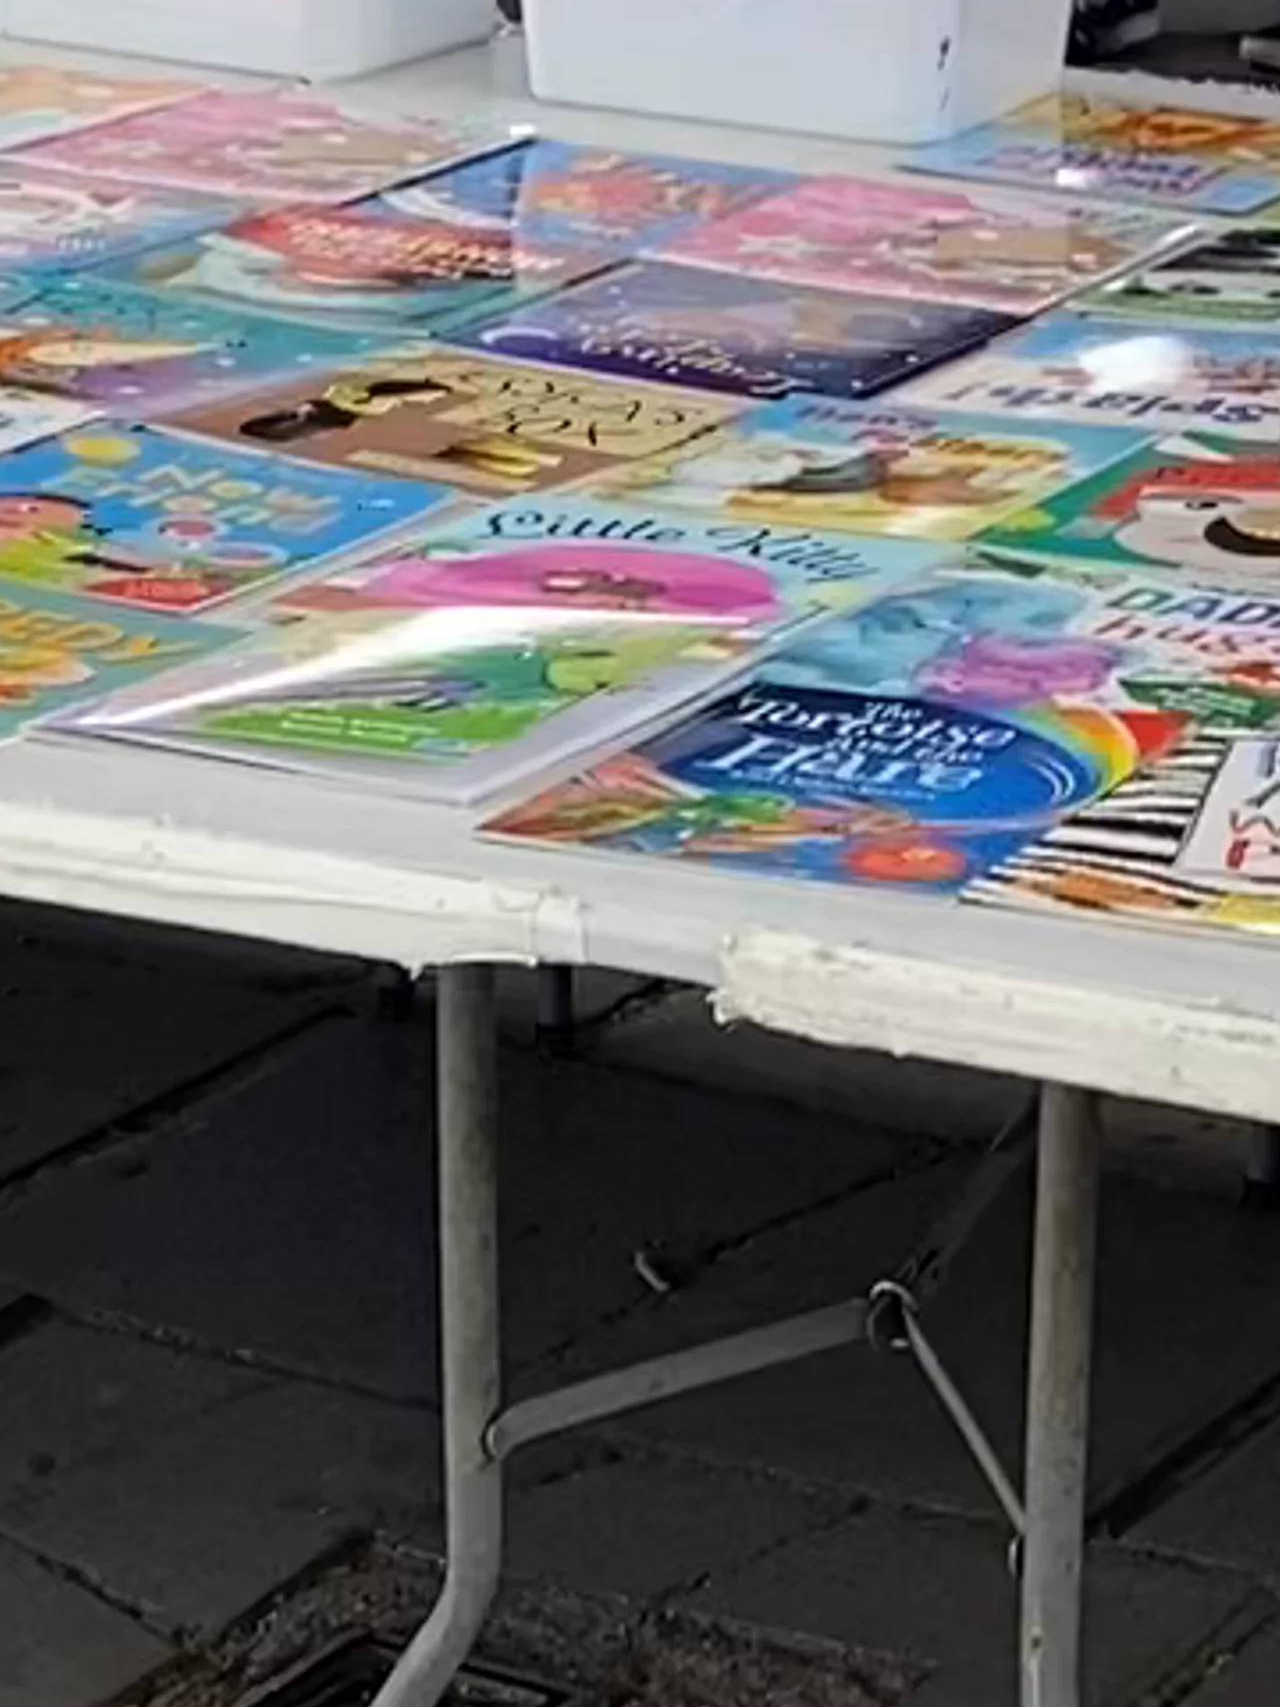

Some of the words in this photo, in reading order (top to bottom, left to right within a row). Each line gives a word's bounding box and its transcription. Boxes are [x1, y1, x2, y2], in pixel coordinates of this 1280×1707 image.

[477, 509, 685, 541] Little
[736, 693, 1018, 749] Tortoise
[695, 733, 983, 791] Hare
